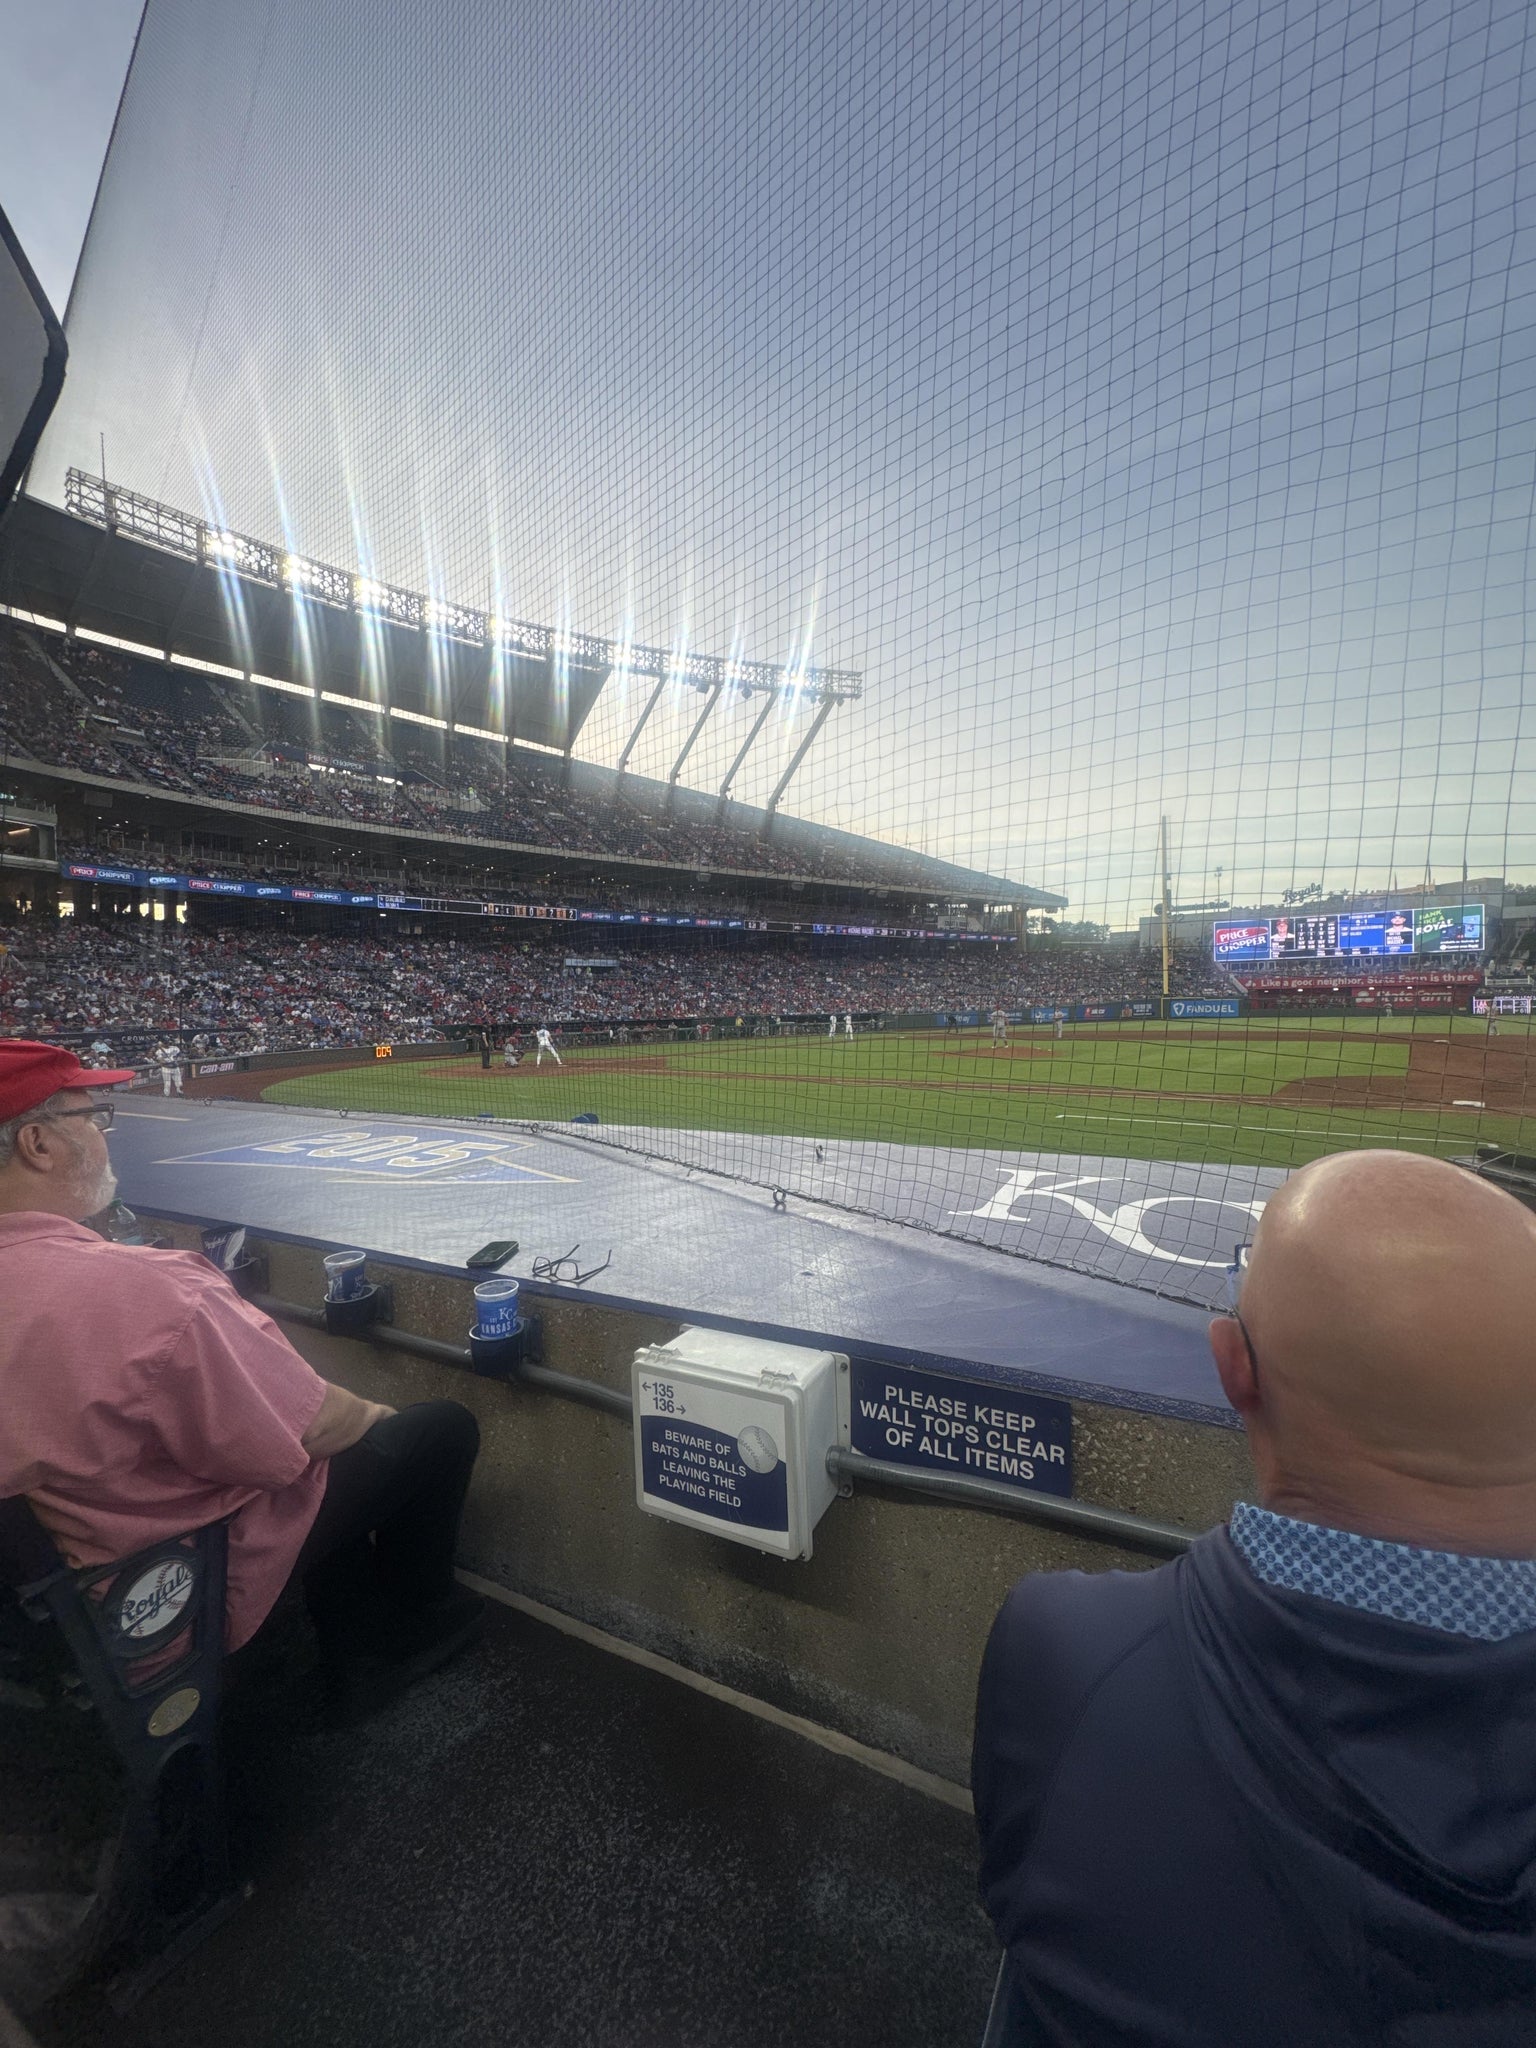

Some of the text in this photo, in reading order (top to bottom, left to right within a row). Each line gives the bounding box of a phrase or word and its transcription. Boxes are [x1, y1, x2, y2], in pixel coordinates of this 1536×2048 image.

[308, 753, 365, 771] PRICE CHOPPER
[72, 867, 132, 881] PRICE CHOPPER
[192, 881, 243, 893] PRICE CHOPPER
[1282, 883, 1321, 903] Royals
[1219, 928, 1250, 943] PRICE
[1219, 936, 1267, 953] CHOPPER
[1261, 979, 1281, 987] Like
[1430, 973, 1440, 982] is
[1186, 1004, 1235, 1014] FANDUEL
[199, 1062, 235, 1074] can-am
[251, 1132, 511, 1168] 2015
[947, 1168, 1268, 1269] KC
[498, 1307, 513, 1321] KC
[481, 1321, 511, 1335] KANSAS
[651, 1382, 674, 1399] 135
[653, 1397, 675, 1413] 136
[884, 1384, 1036, 1433] PLEASE KEEP
[859, 1400, 1065, 1466] WALL TOPS CLEAR
[664, 1429, 731, 1456] BEWARE OF
[651, 1441, 747, 1477] BATS AND BALLS
[885, 1427, 1035, 1481] OF ALL ITEMS
[663, 1460, 736, 1490] LEAVING THE
[659, 1475, 741, 1508] PLAYING FIELD
